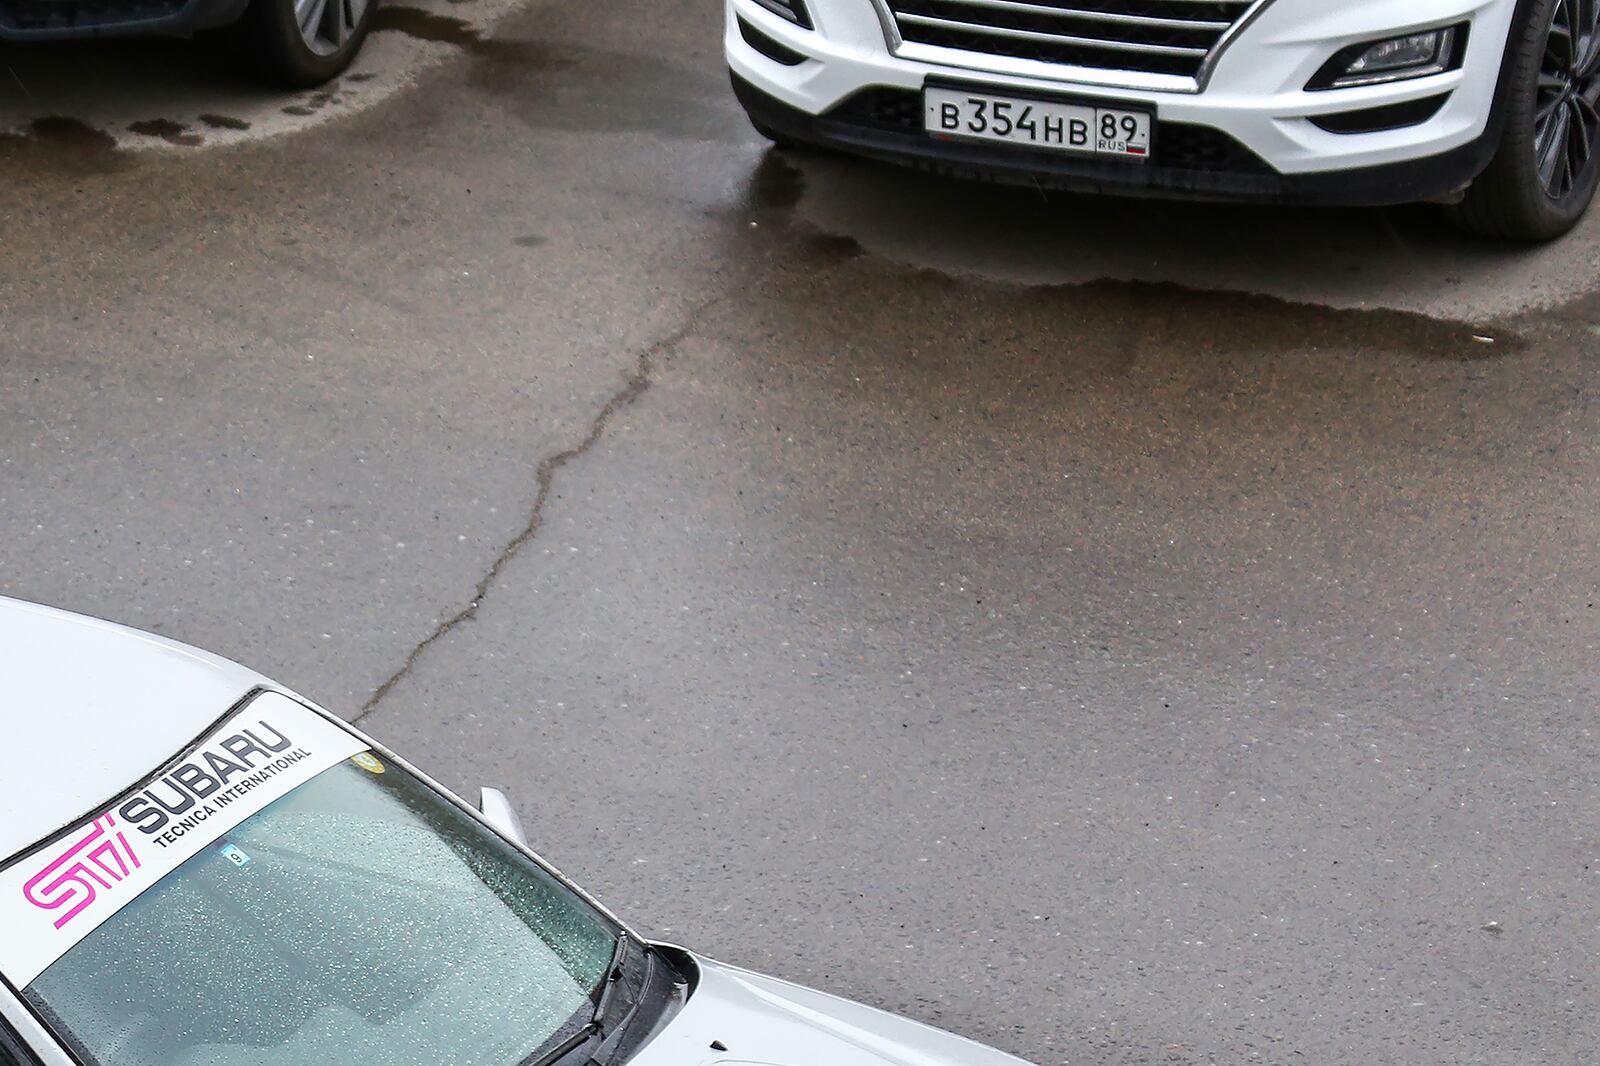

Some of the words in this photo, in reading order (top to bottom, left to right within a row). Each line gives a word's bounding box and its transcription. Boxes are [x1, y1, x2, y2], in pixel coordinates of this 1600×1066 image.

[1098, 139, 1125, 152] RUS
[1101, 113, 1138, 142] 89
[118, 720, 293, 835] SUBARU
[153, 805, 217, 850] TECNICA
[213, 747, 312, 809] INTERNATIONAL
